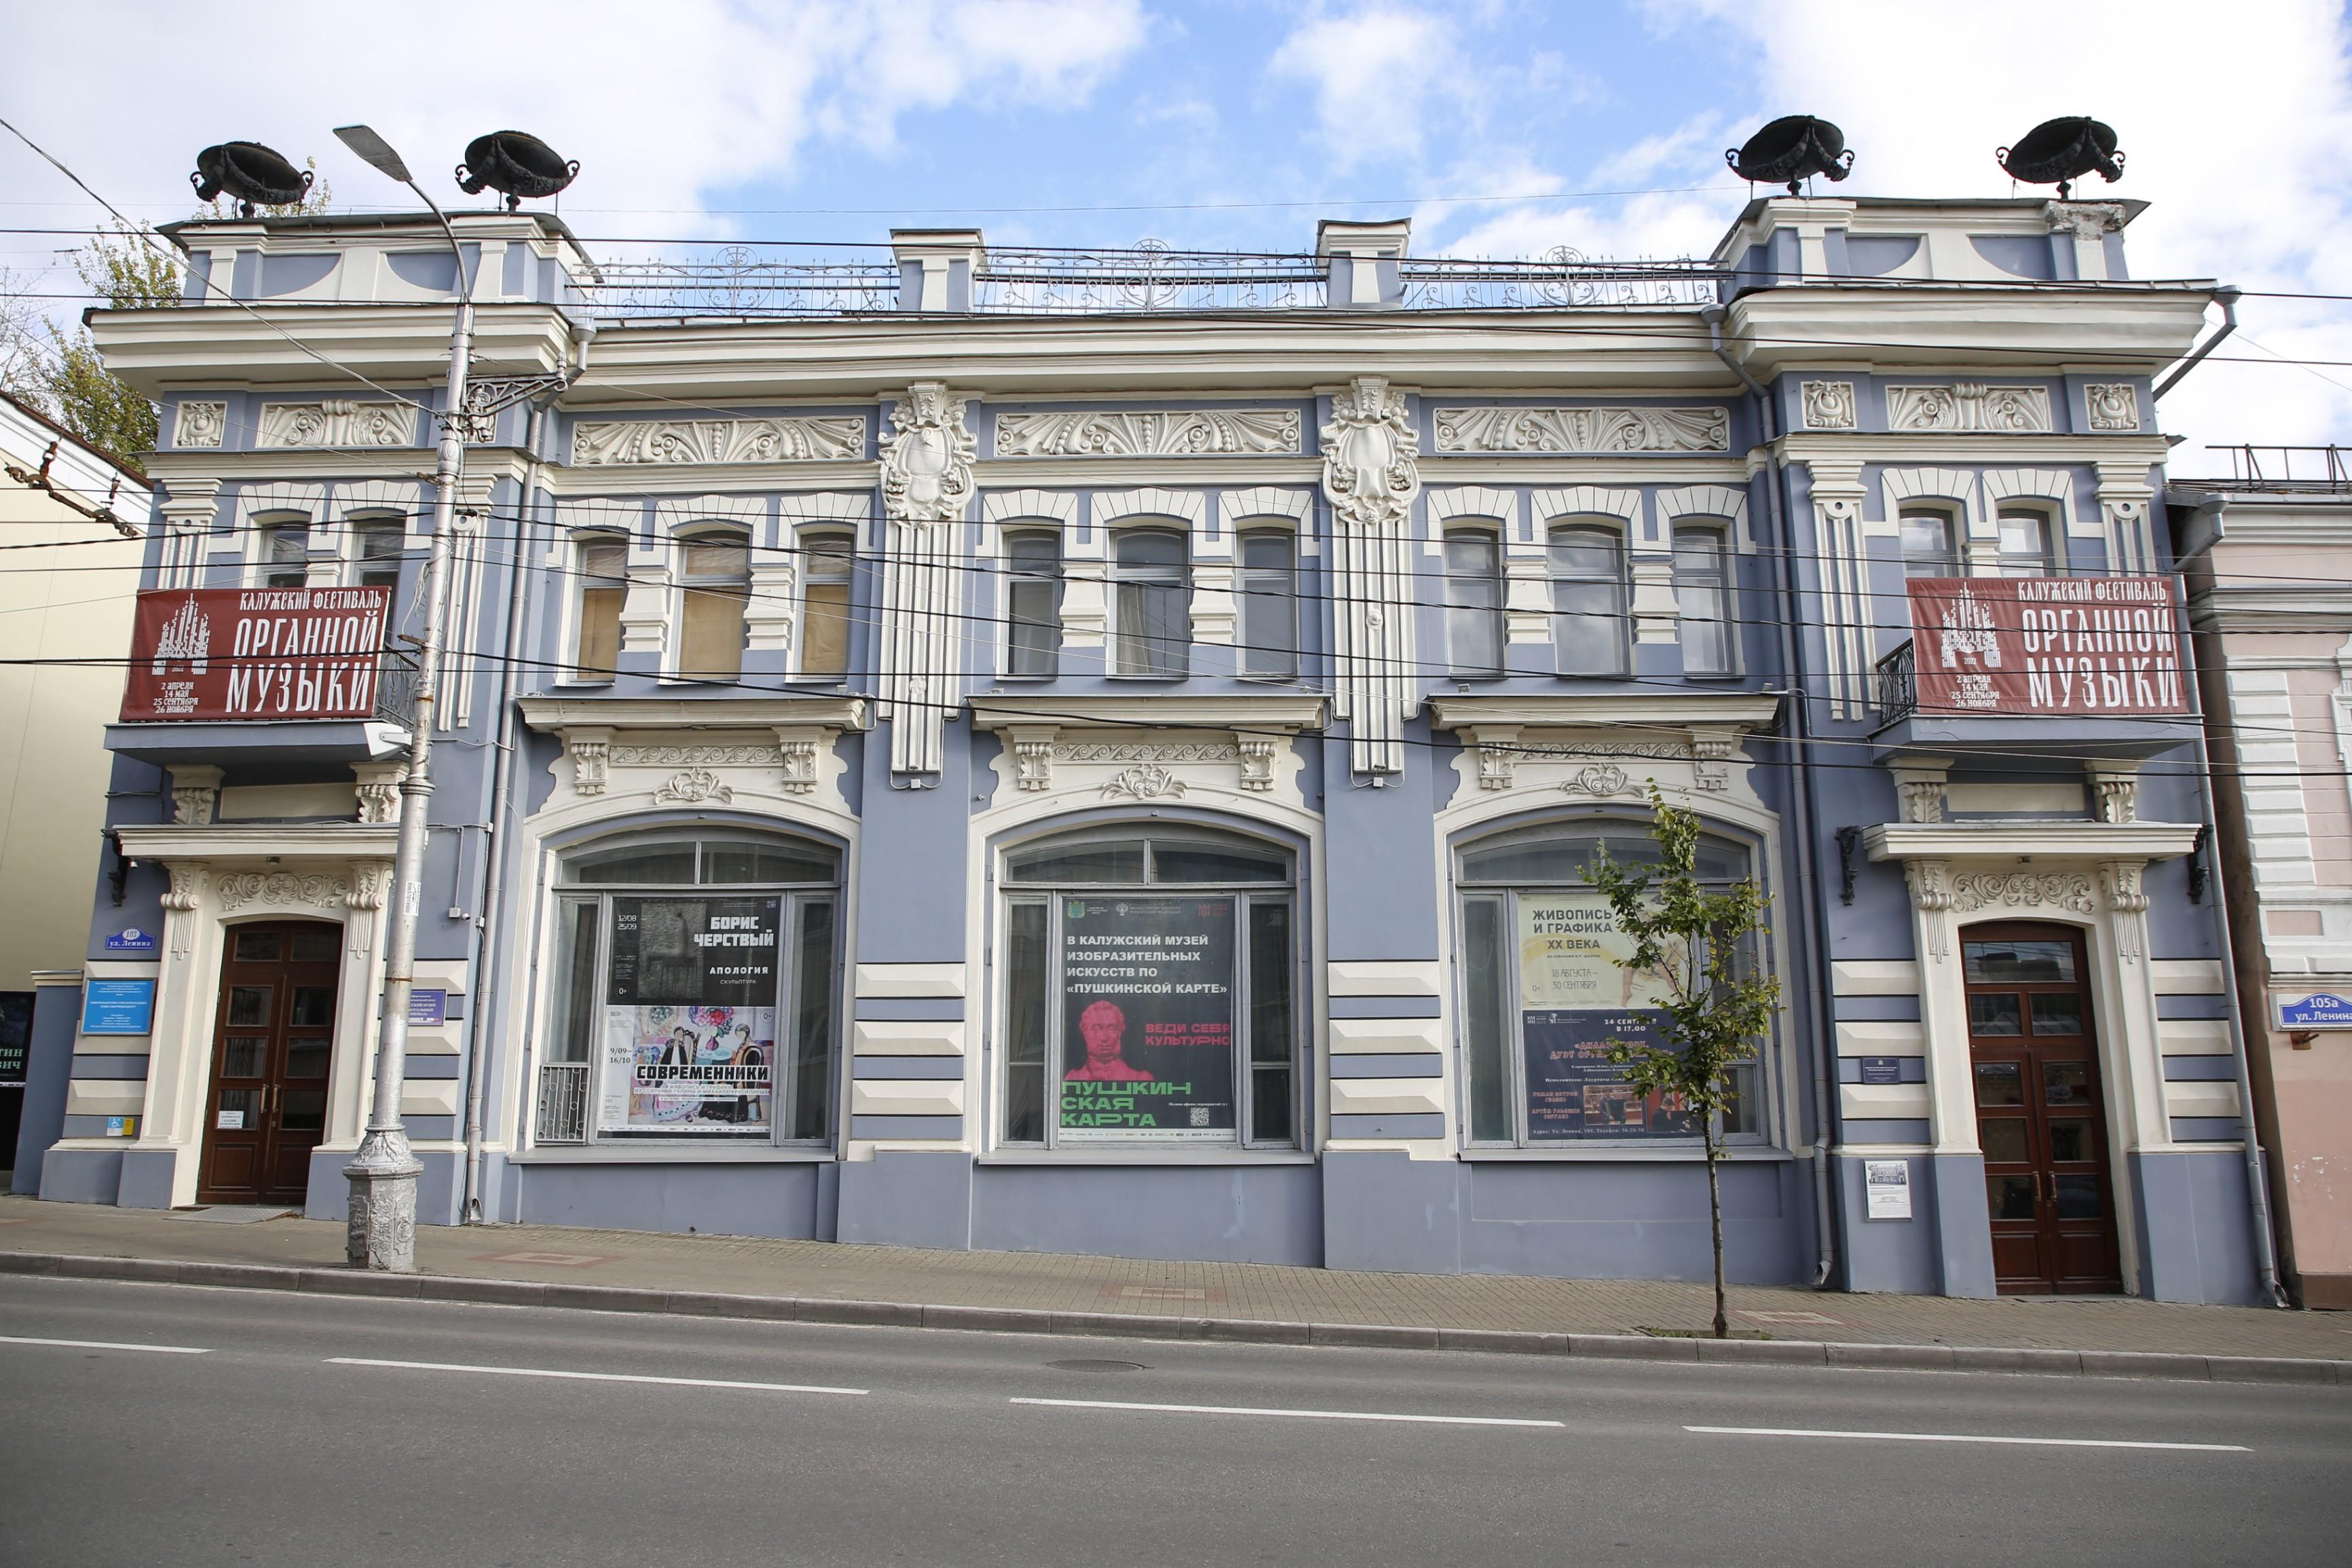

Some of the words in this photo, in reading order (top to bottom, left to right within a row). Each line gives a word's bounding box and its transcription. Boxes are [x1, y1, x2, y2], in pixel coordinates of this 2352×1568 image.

[2017, 579, 2092, 601] КАЛУЖСКИЙ
[2095, 581, 2167, 601] ФЕСТИВАЛЬ
[240, 589, 310, 611] КАЛУЖСКИЙ
[314, 590, 381, 610] ФЕСТИВАЛЬ
[2022, 603, 2172, 652] ОРГАННОЙ
[234, 610, 378, 659] ОРГАННОЙ
[226, 662, 372, 712] МУЗЫКИ
[2027, 656, 2179, 708] МУЗЫКИ
[1951, 691, 1961, 699] 25
[153, 698, 163, 706] 25
[1956, 699, 1966, 707] 26
[1533, 910, 1612, 920] ЖИВОПИСЬ
[711, 916, 759, 929] БОРИС
[1534, 923, 1542, 933] И
[1548, 922, 1613, 933] ГРАФИКА
[694, 929, 774, 946] ЧЕРСТВЫЙ
[1067, 936, 1075, 945] В
[1079, 934, 1161, 945] КАЛУЖСКИЙ
[1165, 934, 1208, 945] МУЗЕЙ
[1567, 939, 1601, 949] ВЕКА
[1067, 952, 1200, 961] ИЗОБРАЗИТЕЛЬНЫХ
[1067, 967, 1134, 977] ИСКУССТВ
[1139, 967, 1157, 977] ПО
[1552, 969, 1559, 977] 18
[1561, 969, 1591, 977] АВГУСТА
[1067, 982, 1171, 993] «ПУШКИНСКОЙ
[1176, 984, 1227, 994] КАРТЕ»
[1563, 981, 1597, 989] СЕНТЯБРЯ
[2309, 998, 2339, 1008] 105а
[2294, 1013, 2312, 1023] ул.
[1146, 1024, 1187, 1034] ВЕДИ
[1191, 1024, 1231, 1034] СЕБЯ
[1146, 1036, 1231, 1046] КУЛЬТУРНО
[1550, 1051, 1575, 1060] ДУЭТ
[637, 1066, 768, 1080] СОВРЕМЕННИКИ
[1062, 1082, 1191, 1095] ПУШКИН
[1061, 1097, 1134, 1110] СКАЯ
[1061, 1113, 1157, 1126] КАРТА
